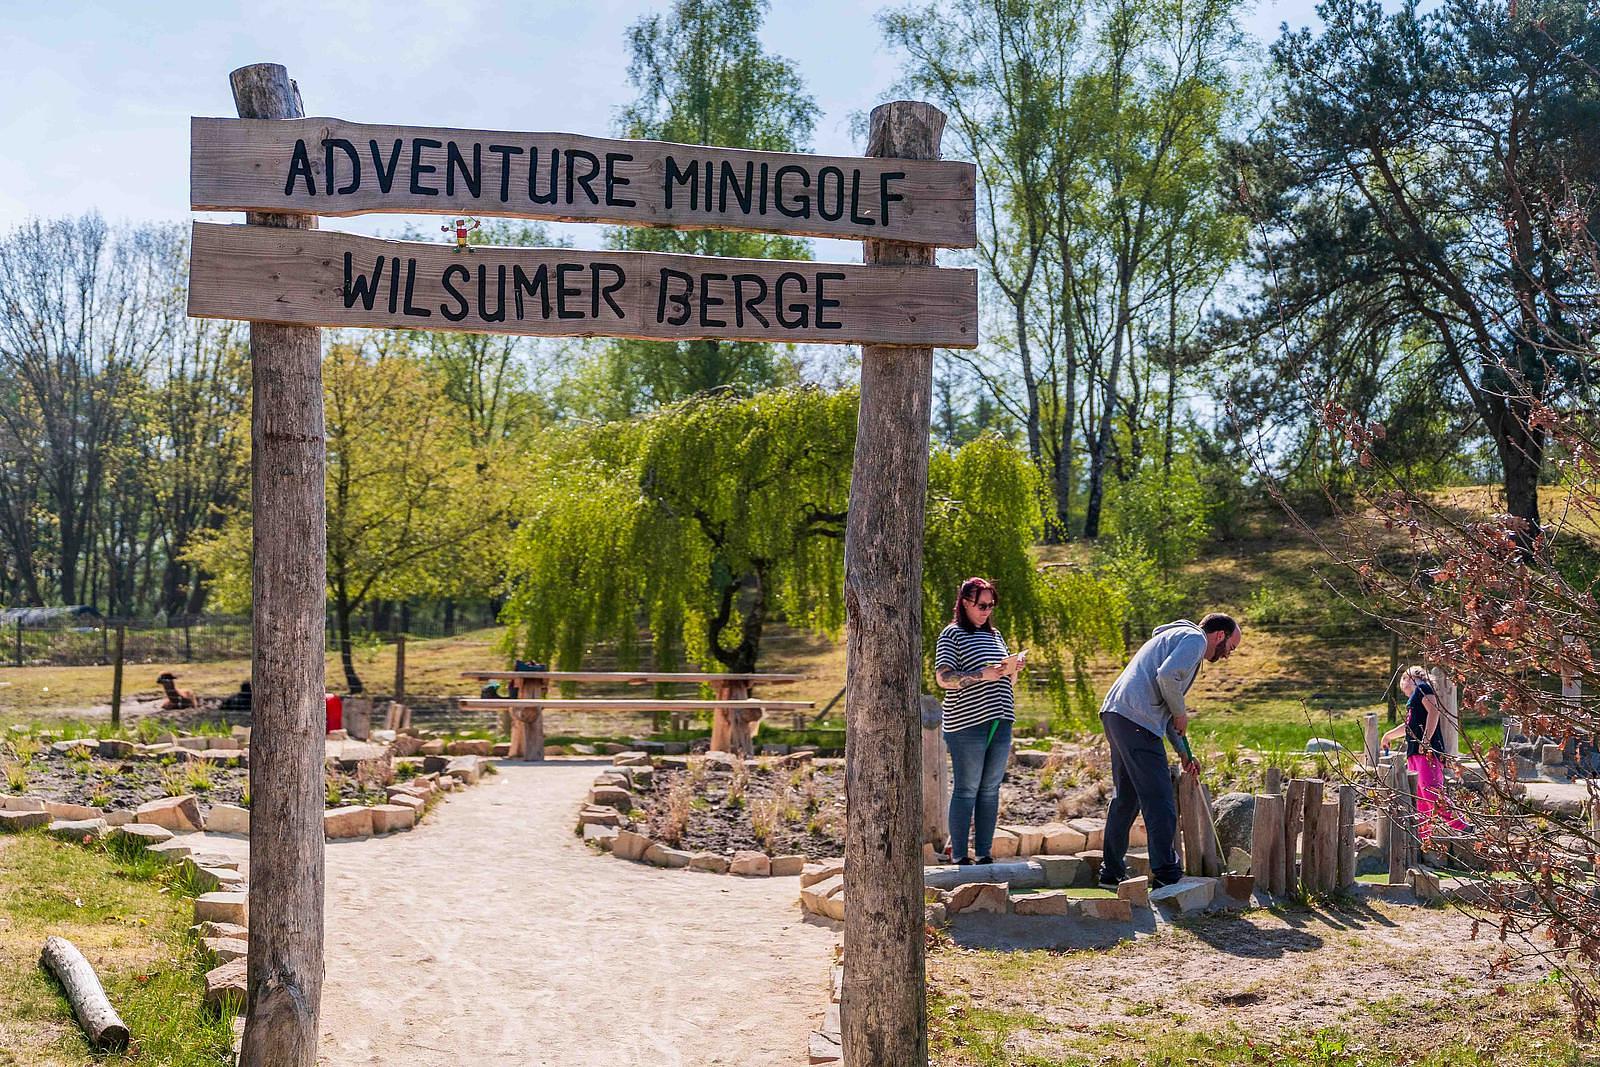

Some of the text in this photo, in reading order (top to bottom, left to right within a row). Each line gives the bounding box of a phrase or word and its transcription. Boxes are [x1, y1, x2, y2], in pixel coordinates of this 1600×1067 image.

[284, 138, 906, 227] ADVENTURE MINIGOLF
[343, 251, 846, 329] WILSUMER BERGE
